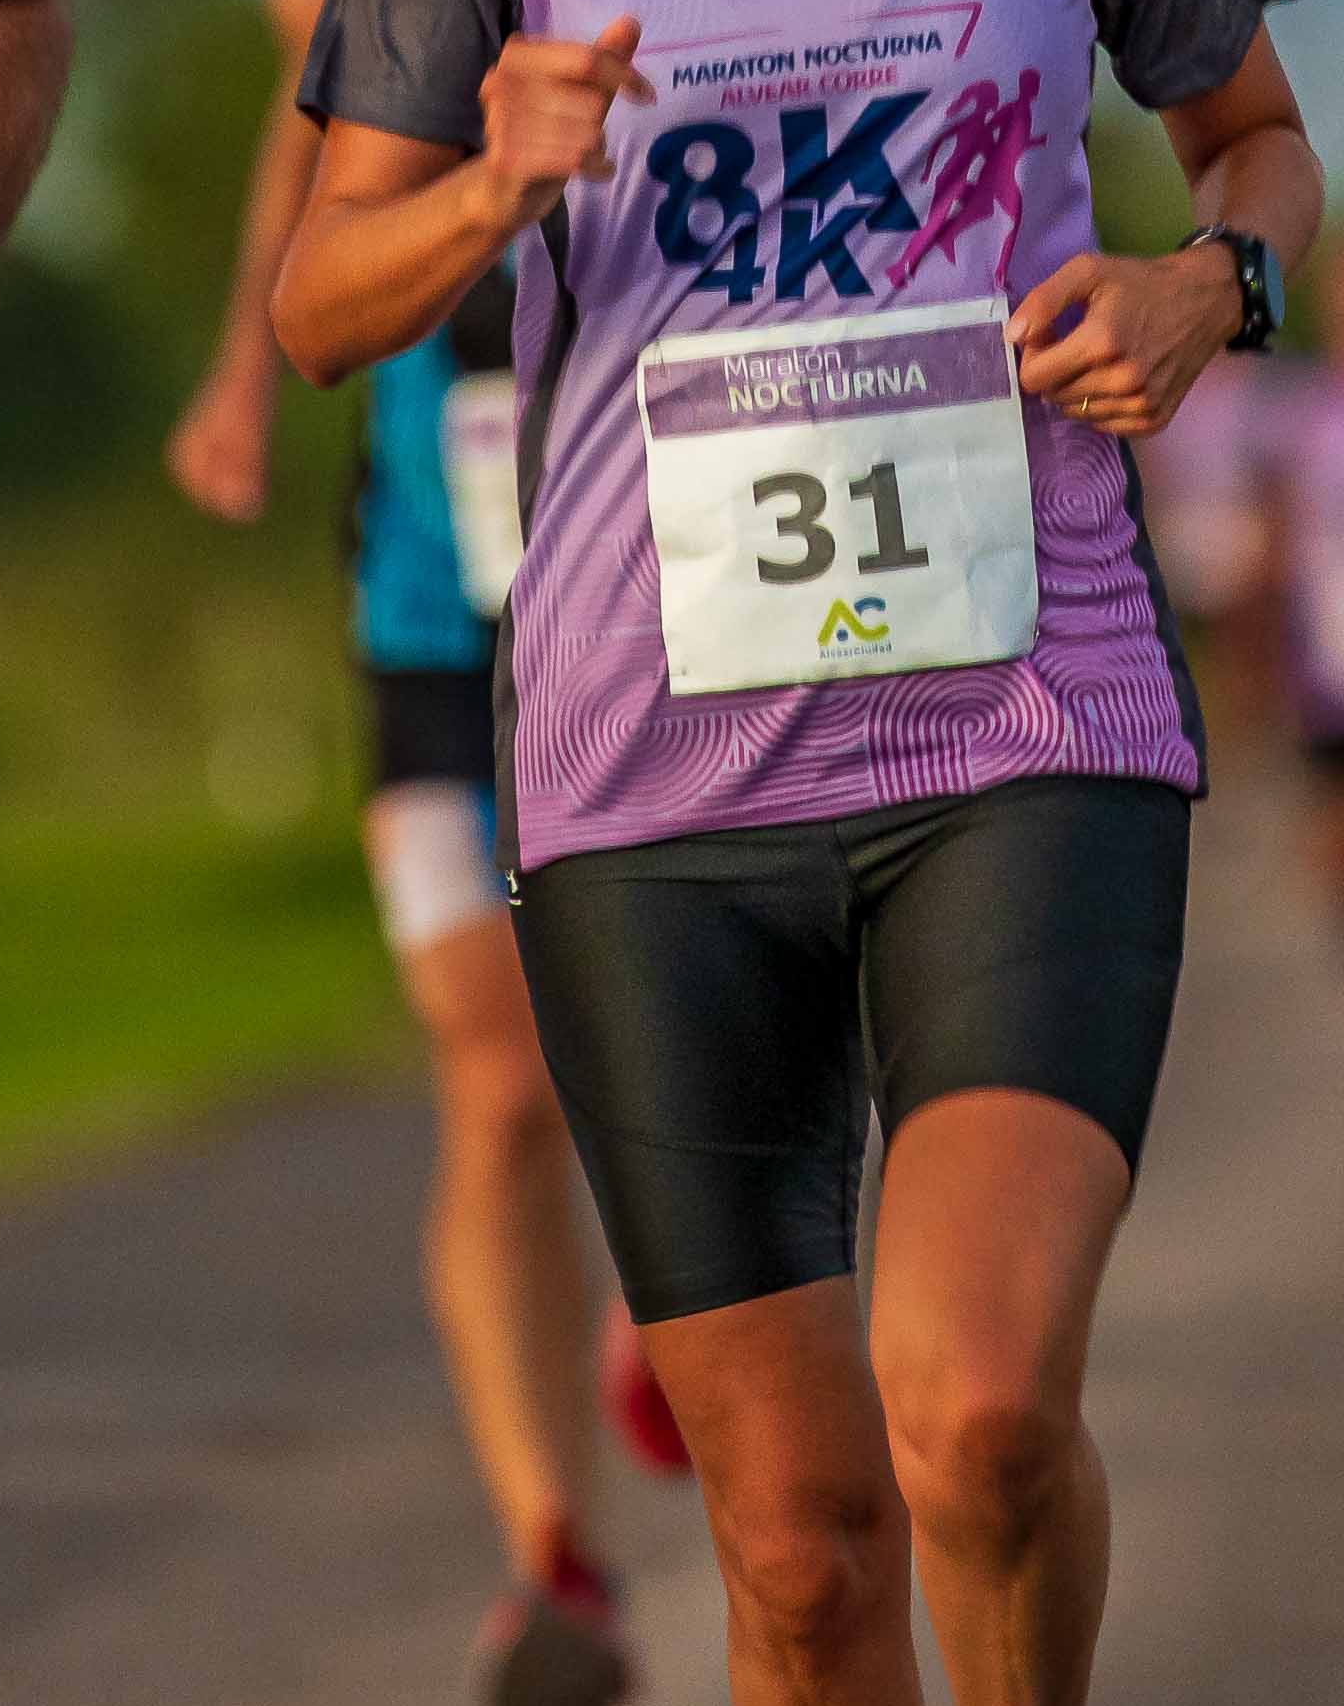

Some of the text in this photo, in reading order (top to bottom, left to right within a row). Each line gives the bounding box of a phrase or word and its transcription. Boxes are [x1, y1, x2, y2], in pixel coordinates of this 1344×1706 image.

[672, 29, 943, 89] MARATON NOCTURNA
[646, 88, 932, 266] 8K
[692, 205, 875, 306] 4K
[727, 359, 928, 414] NOCTURNA
[752, 462, 930, 585] 31
